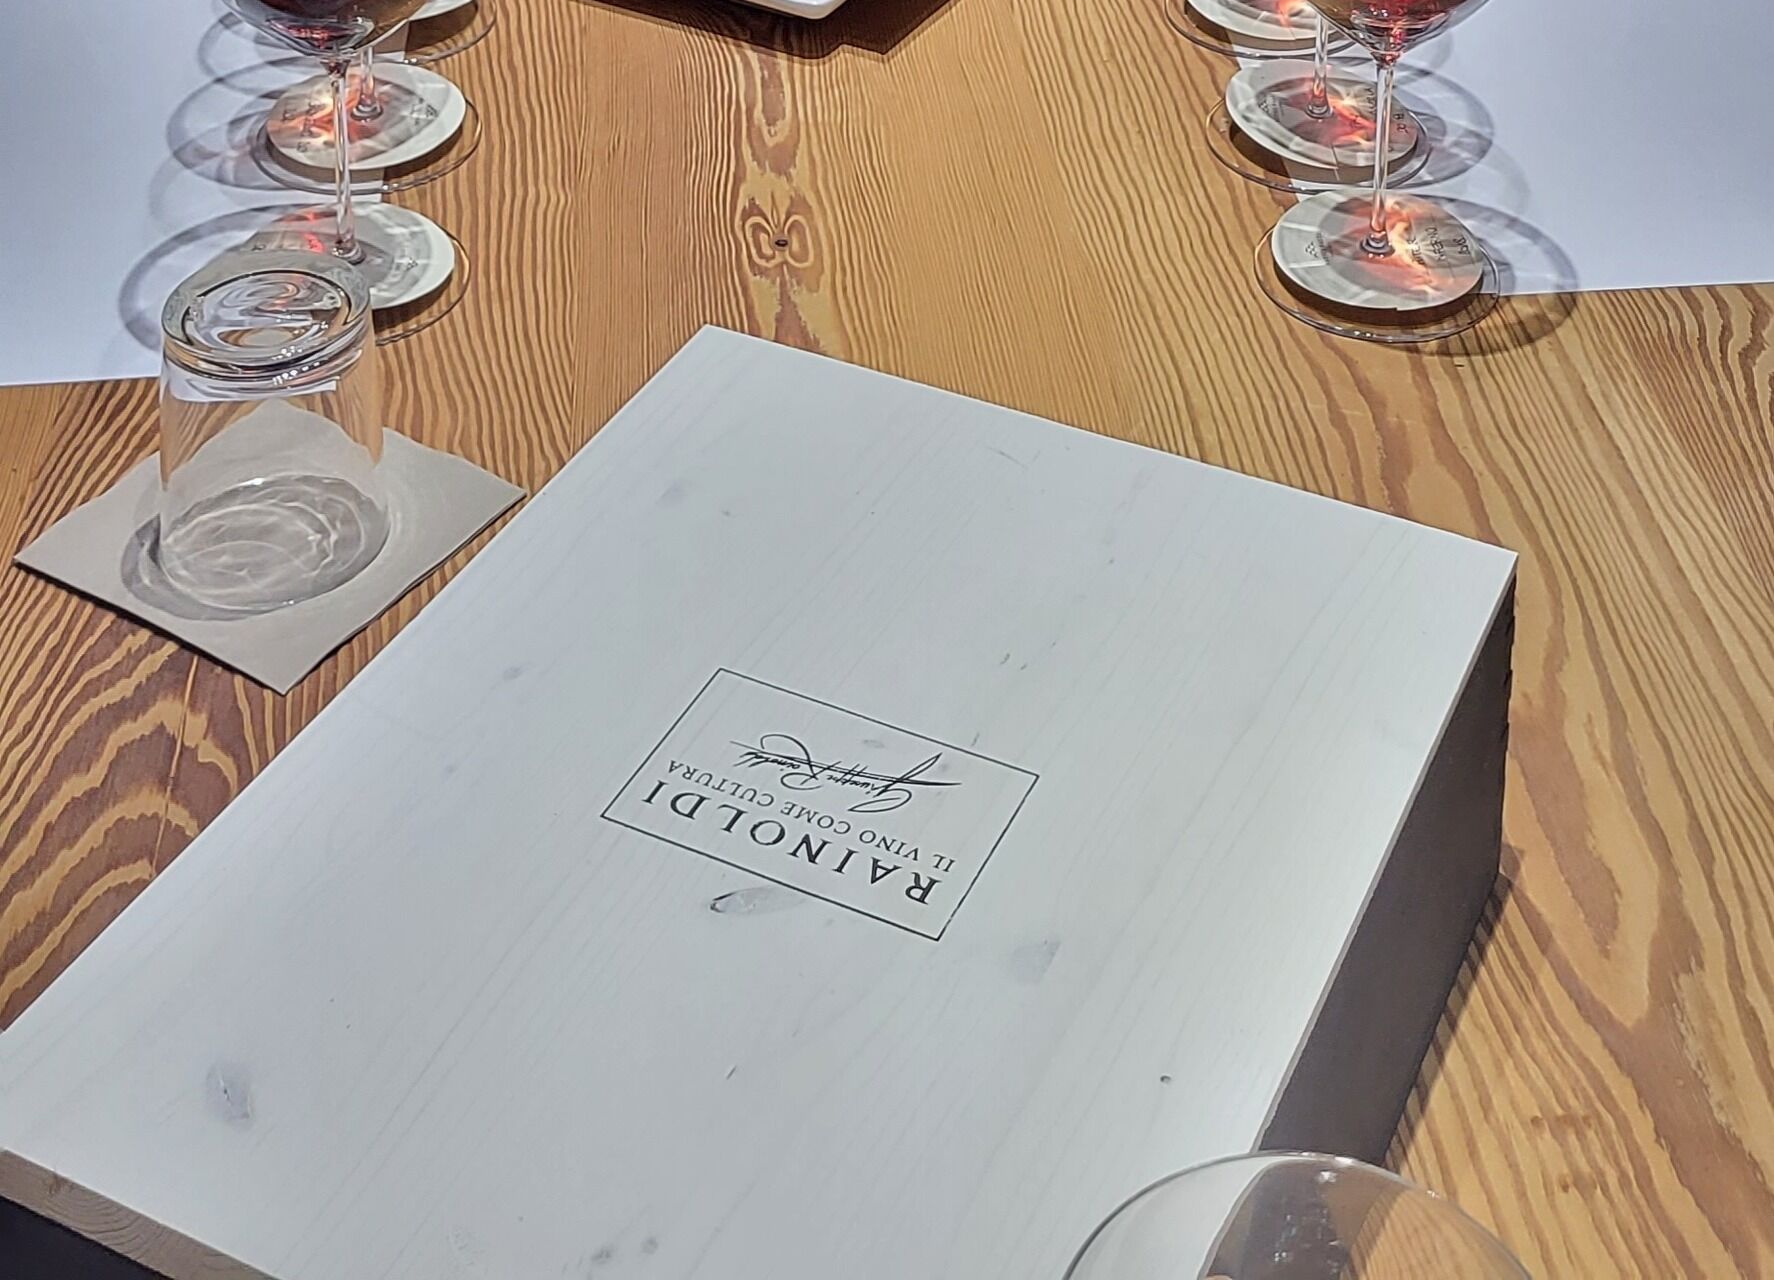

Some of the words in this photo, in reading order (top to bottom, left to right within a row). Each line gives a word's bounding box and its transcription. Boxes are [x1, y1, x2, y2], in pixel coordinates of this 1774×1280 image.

[669, 759, 775, 808] CULTURA
[778, 801, 851, 835] COME
[642, 780, 943, 906] RAINOLDI
[858, 829, 921, 861] VINO
[932, 851, 956, 874] IL
